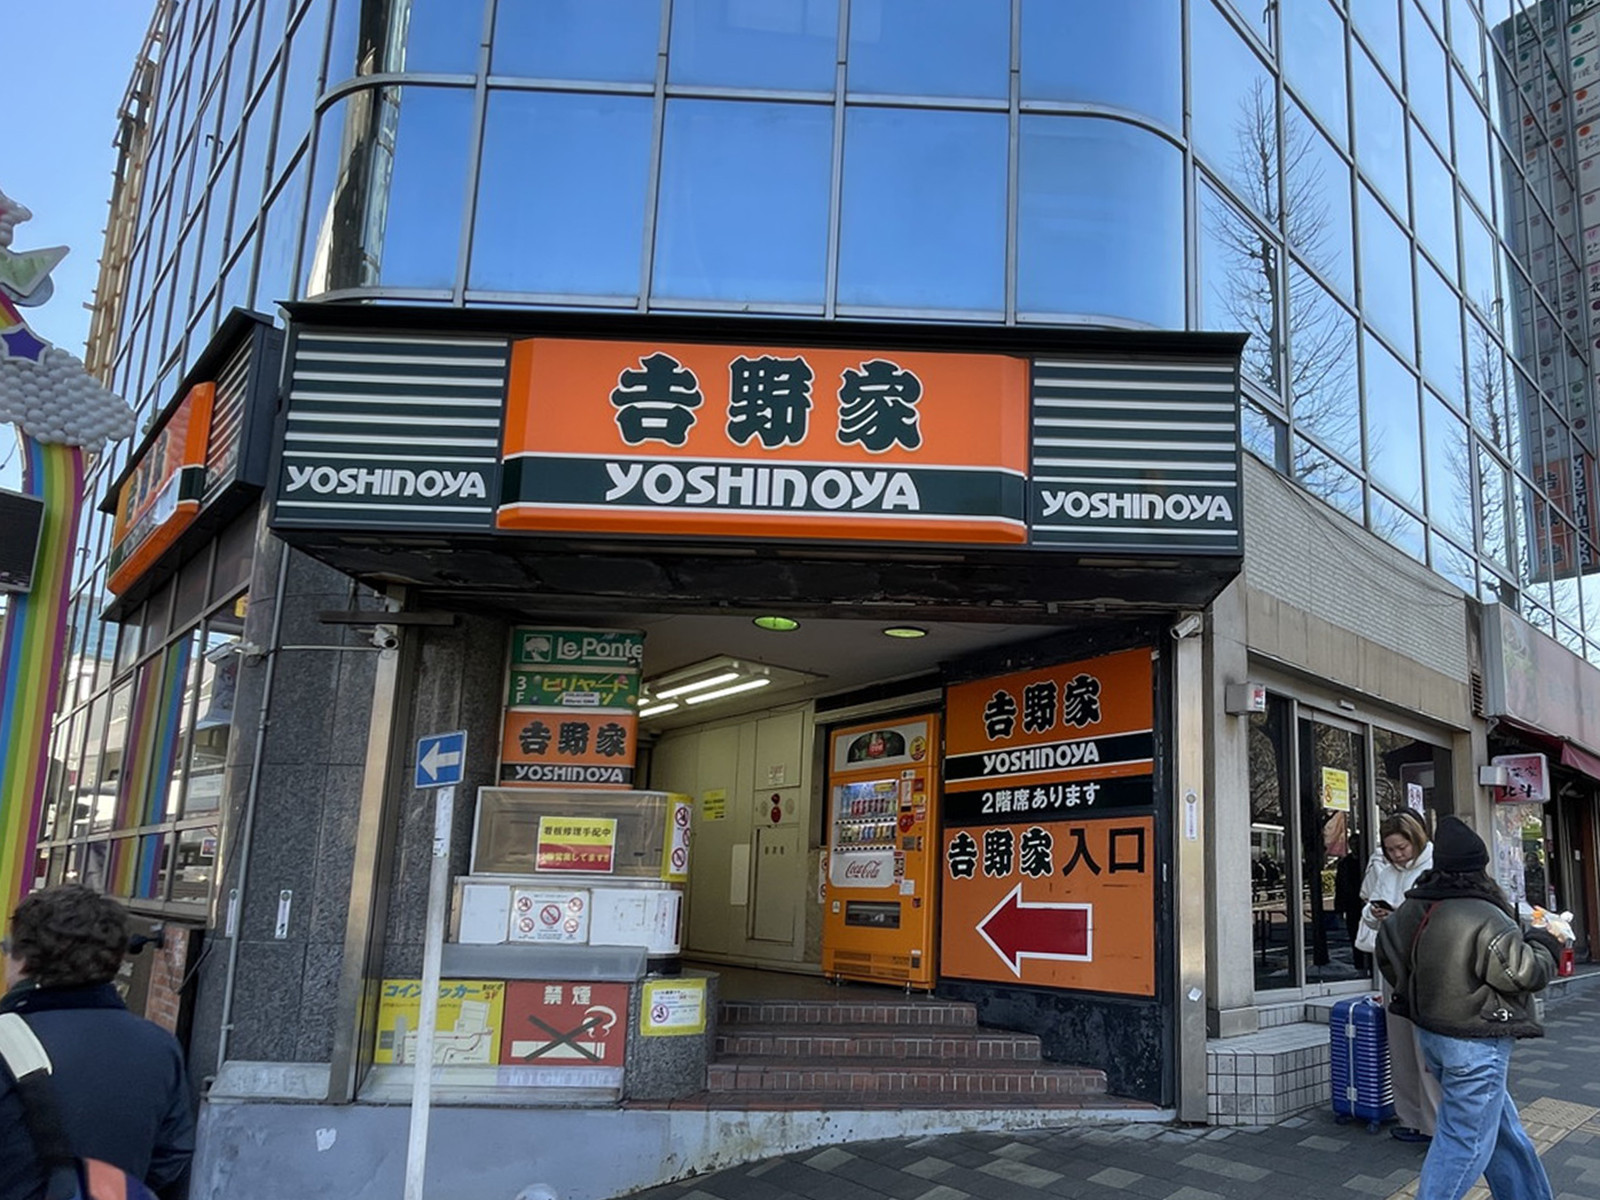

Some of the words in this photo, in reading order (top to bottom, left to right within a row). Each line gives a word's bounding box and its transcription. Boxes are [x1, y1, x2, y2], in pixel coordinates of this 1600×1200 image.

[609, 351, 924, 454] 吉野家
[286, 465, 486, 498] YOSHINOYA
[605, 462, 920, 511] YOSHINOYA
[1041, 490, 1233, 522] YOSHINOYA
[982, 673, 1102, 741] 吉野家
[519, 720, 627, 757] 吉野家
[515, 765, 623, 783] YOSHINOYA
[983, 741, 1100, 774] YOSHINOYA
[981, 782, 1101, 814] 2階席あります
[383, 982, 481, 999] コインッカー
[543, 985, 592, 1006] 禁煙
